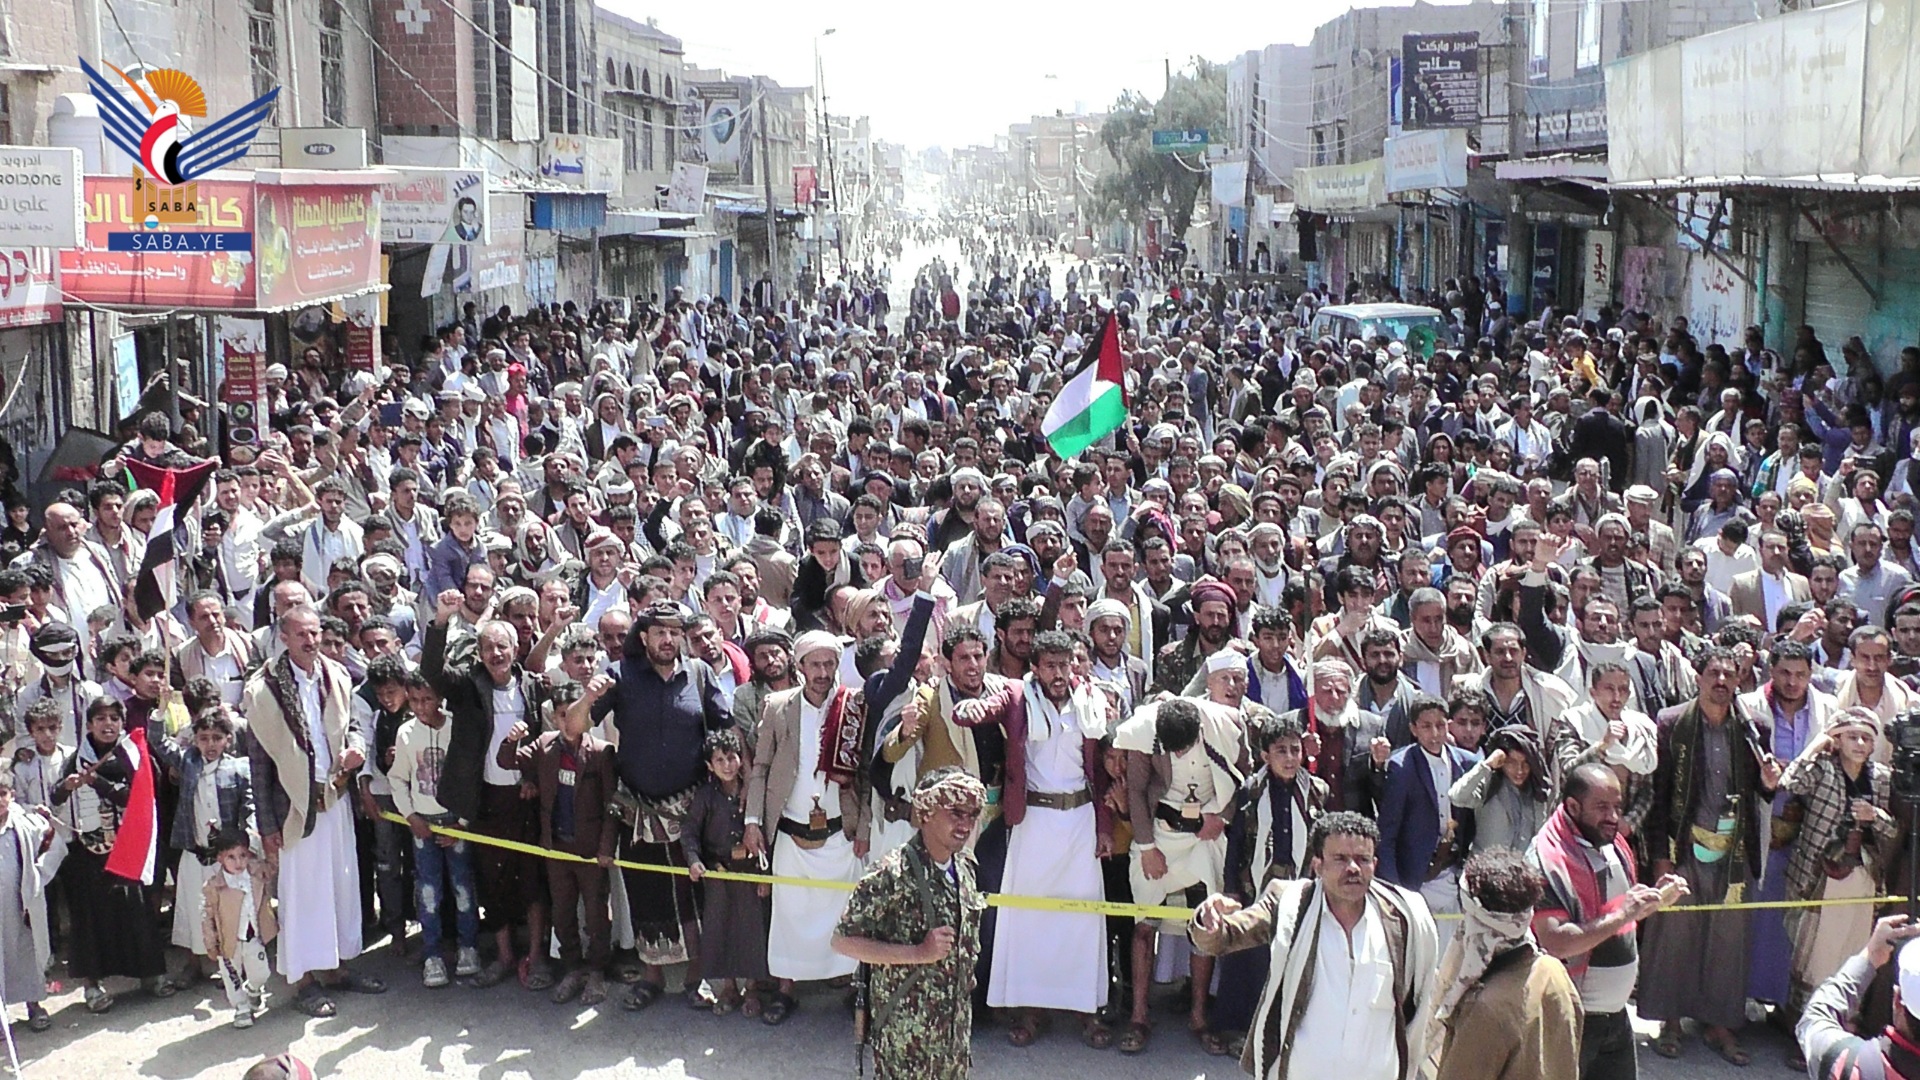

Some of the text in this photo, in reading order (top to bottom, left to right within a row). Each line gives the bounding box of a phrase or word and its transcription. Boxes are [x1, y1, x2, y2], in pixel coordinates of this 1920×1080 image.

[1416, 40, 1450, 53] ماركت
[1418, 57, 1461, 75] صلاح
[1, 154, 42, 167] اندرويد
